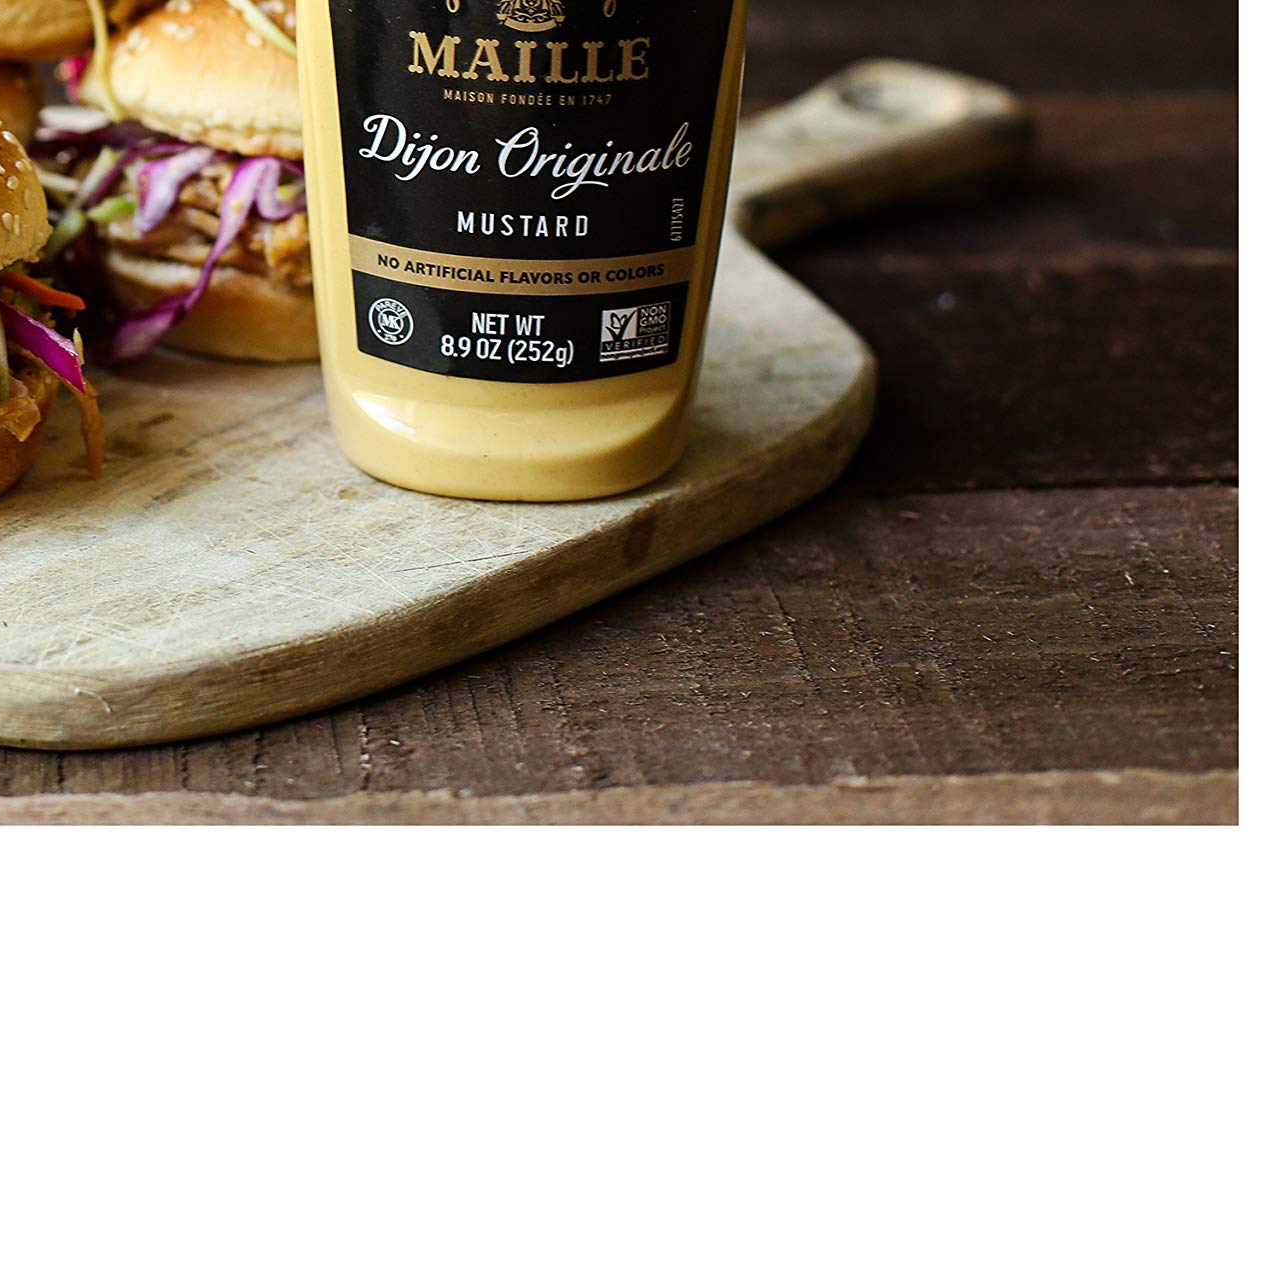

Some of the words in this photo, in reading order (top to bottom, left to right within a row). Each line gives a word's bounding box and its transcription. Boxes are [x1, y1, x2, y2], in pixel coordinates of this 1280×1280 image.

[407, 30, 651, 85] MAILLE
[443, 89, 495, 104] MAISON
[501, 92, 552, 106] FONDÉE
[559, 95, 575, 106] EN
[582, 94, 612, 106] 1747
[358, 114, 481, 181] Dijon
[495, 122, 692, 200] Originale
[457, 210, 589, 238] MUSTARD
[377, 254, 400, 271] NO
[404, 262, 495, 284] ARTIFICIAL
[500, 271, 573, 285] FLAVORS
[578, 272, 601, 284] OR
[605, 264, 665, 282] COLORS
[472, 312, 510, 336] NET
[515, 315, 545, 336] WT
[639, 314, 667, 327] GMO
[640, 305, 667, 317] NON
[440, 334, 472, 358] 8.9
[476, 337, 502, 360] OZ
[507, 341, 575, 368] (252g)
[605, 335, 666, 351] VERIFIED
